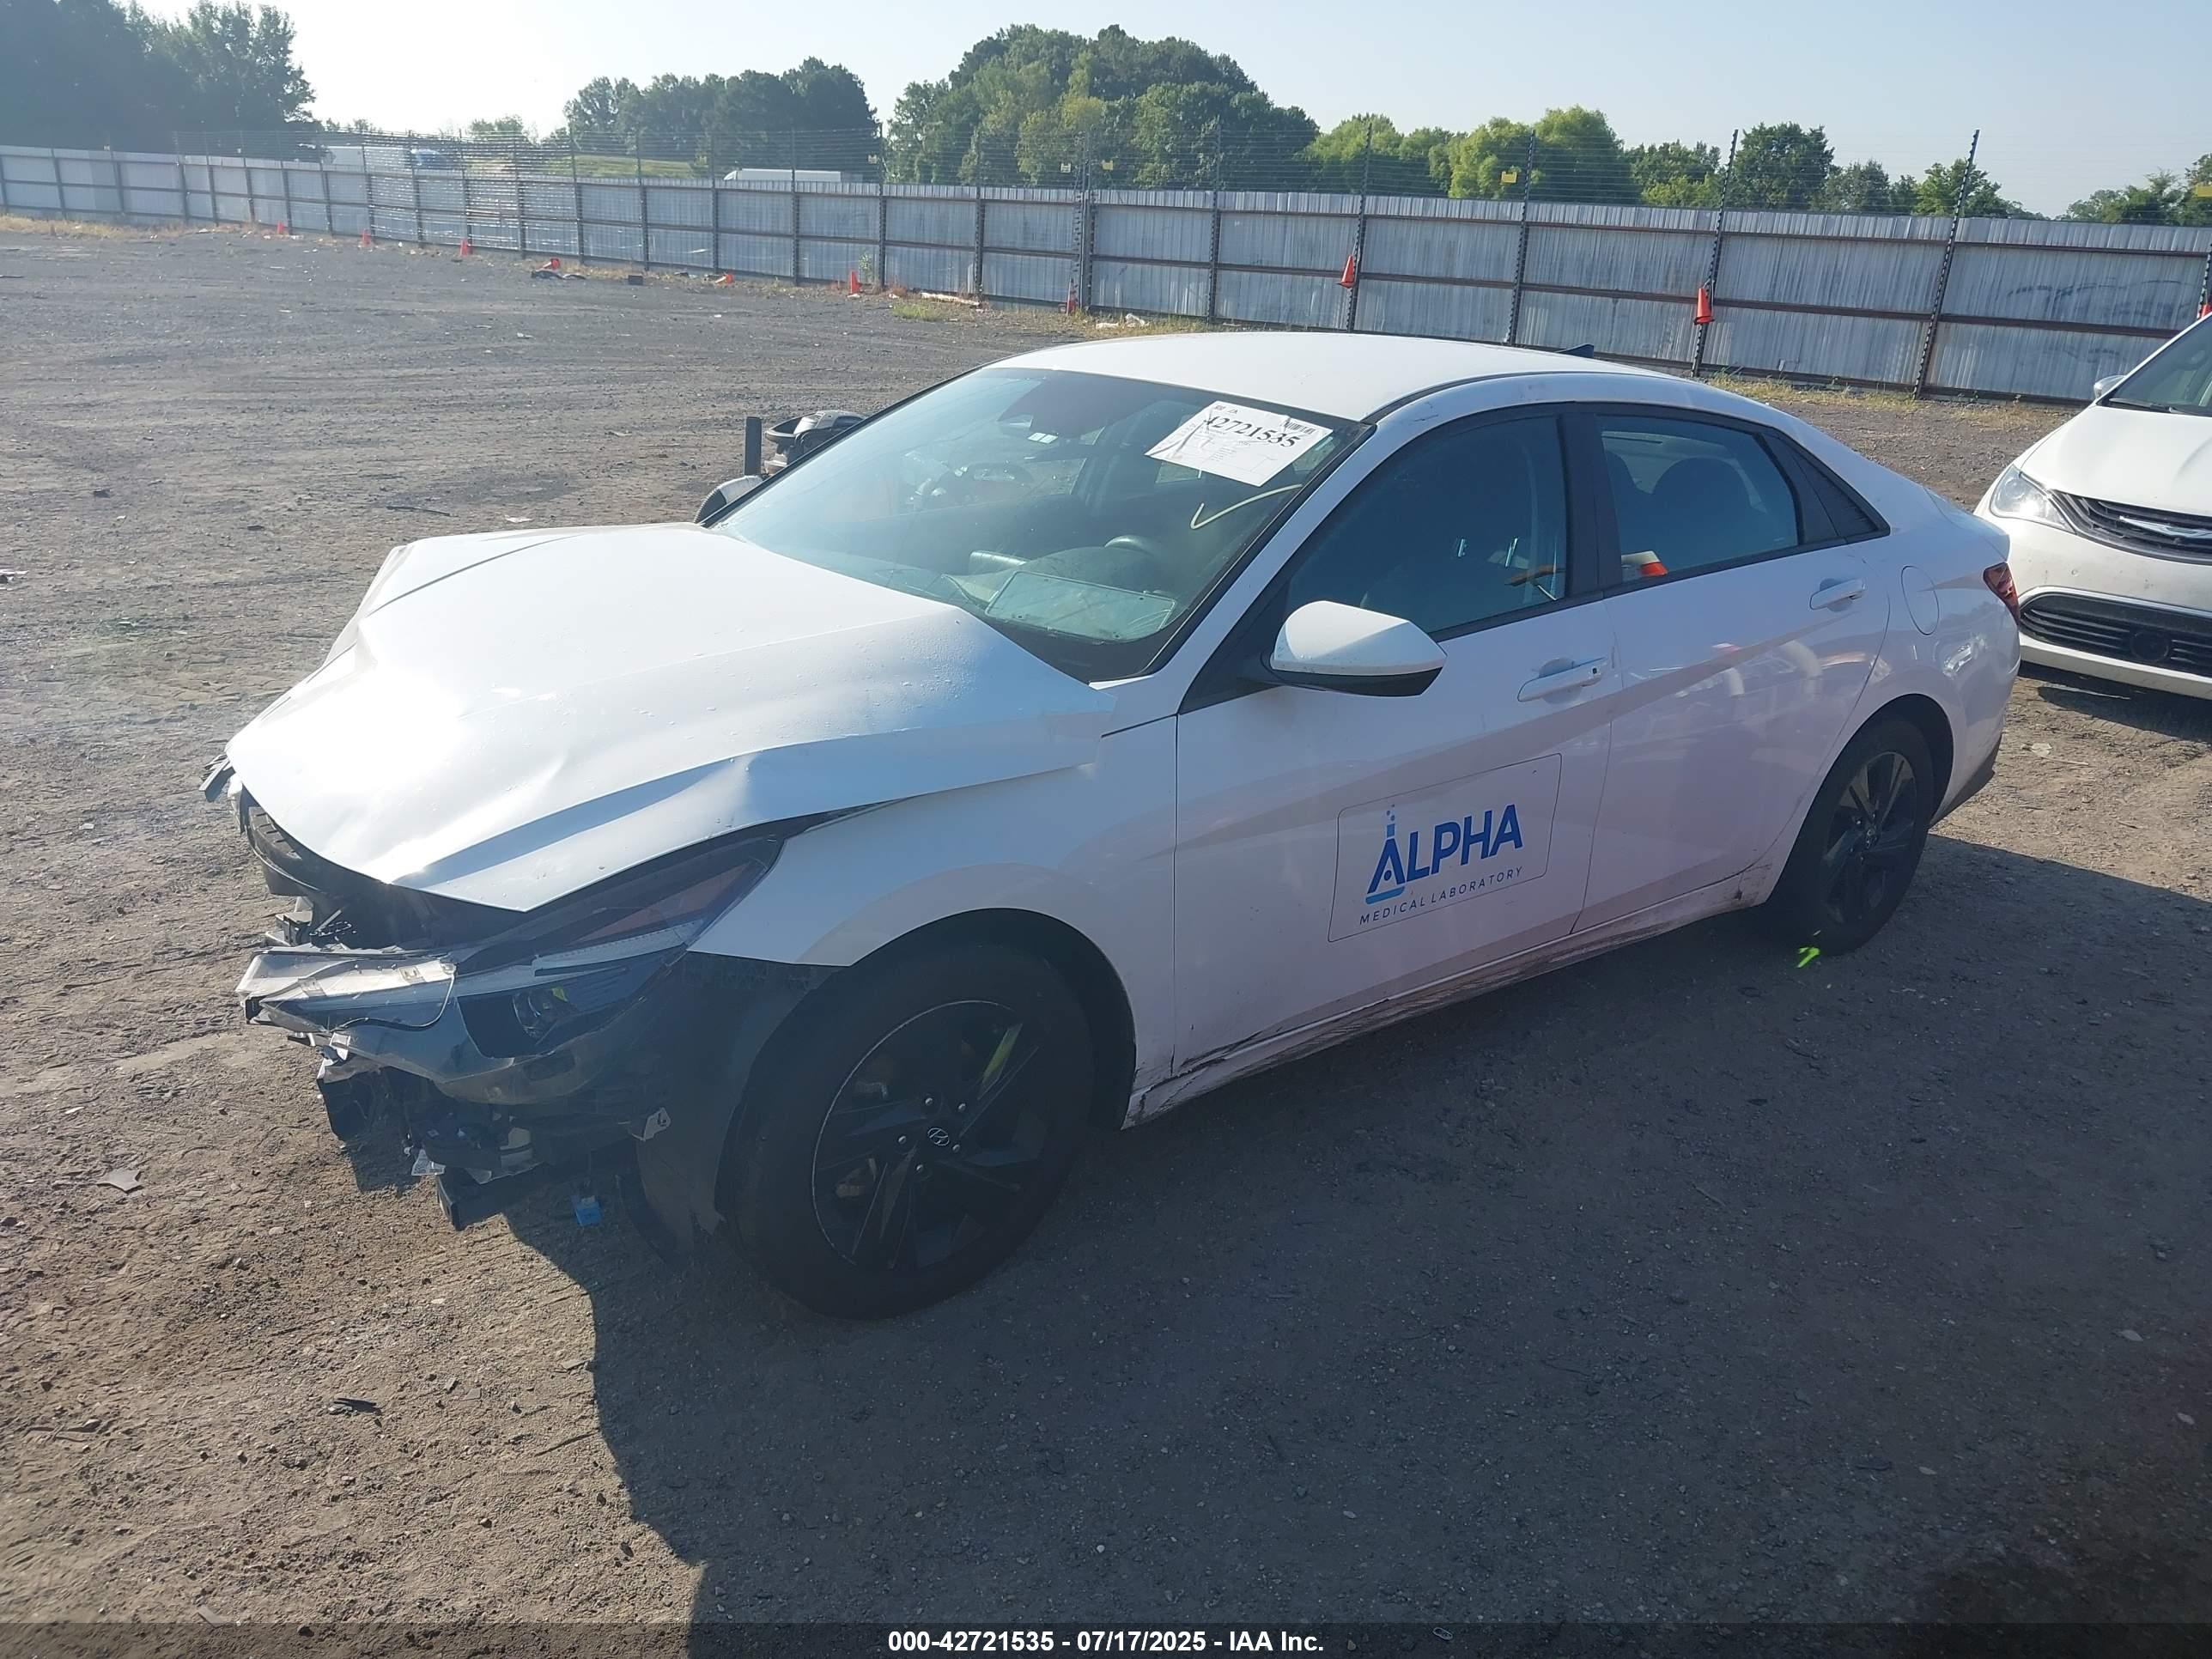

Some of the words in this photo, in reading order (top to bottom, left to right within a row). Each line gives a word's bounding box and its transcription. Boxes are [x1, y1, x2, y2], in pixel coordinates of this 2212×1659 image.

[1203, 416, 1300, 447] 42721535
[1367, 804, 1523, 895] ALPHA
[1359, 899, 1426, 925] MEDICAL
[1431, 866, 1523, 904] LABORATORY
